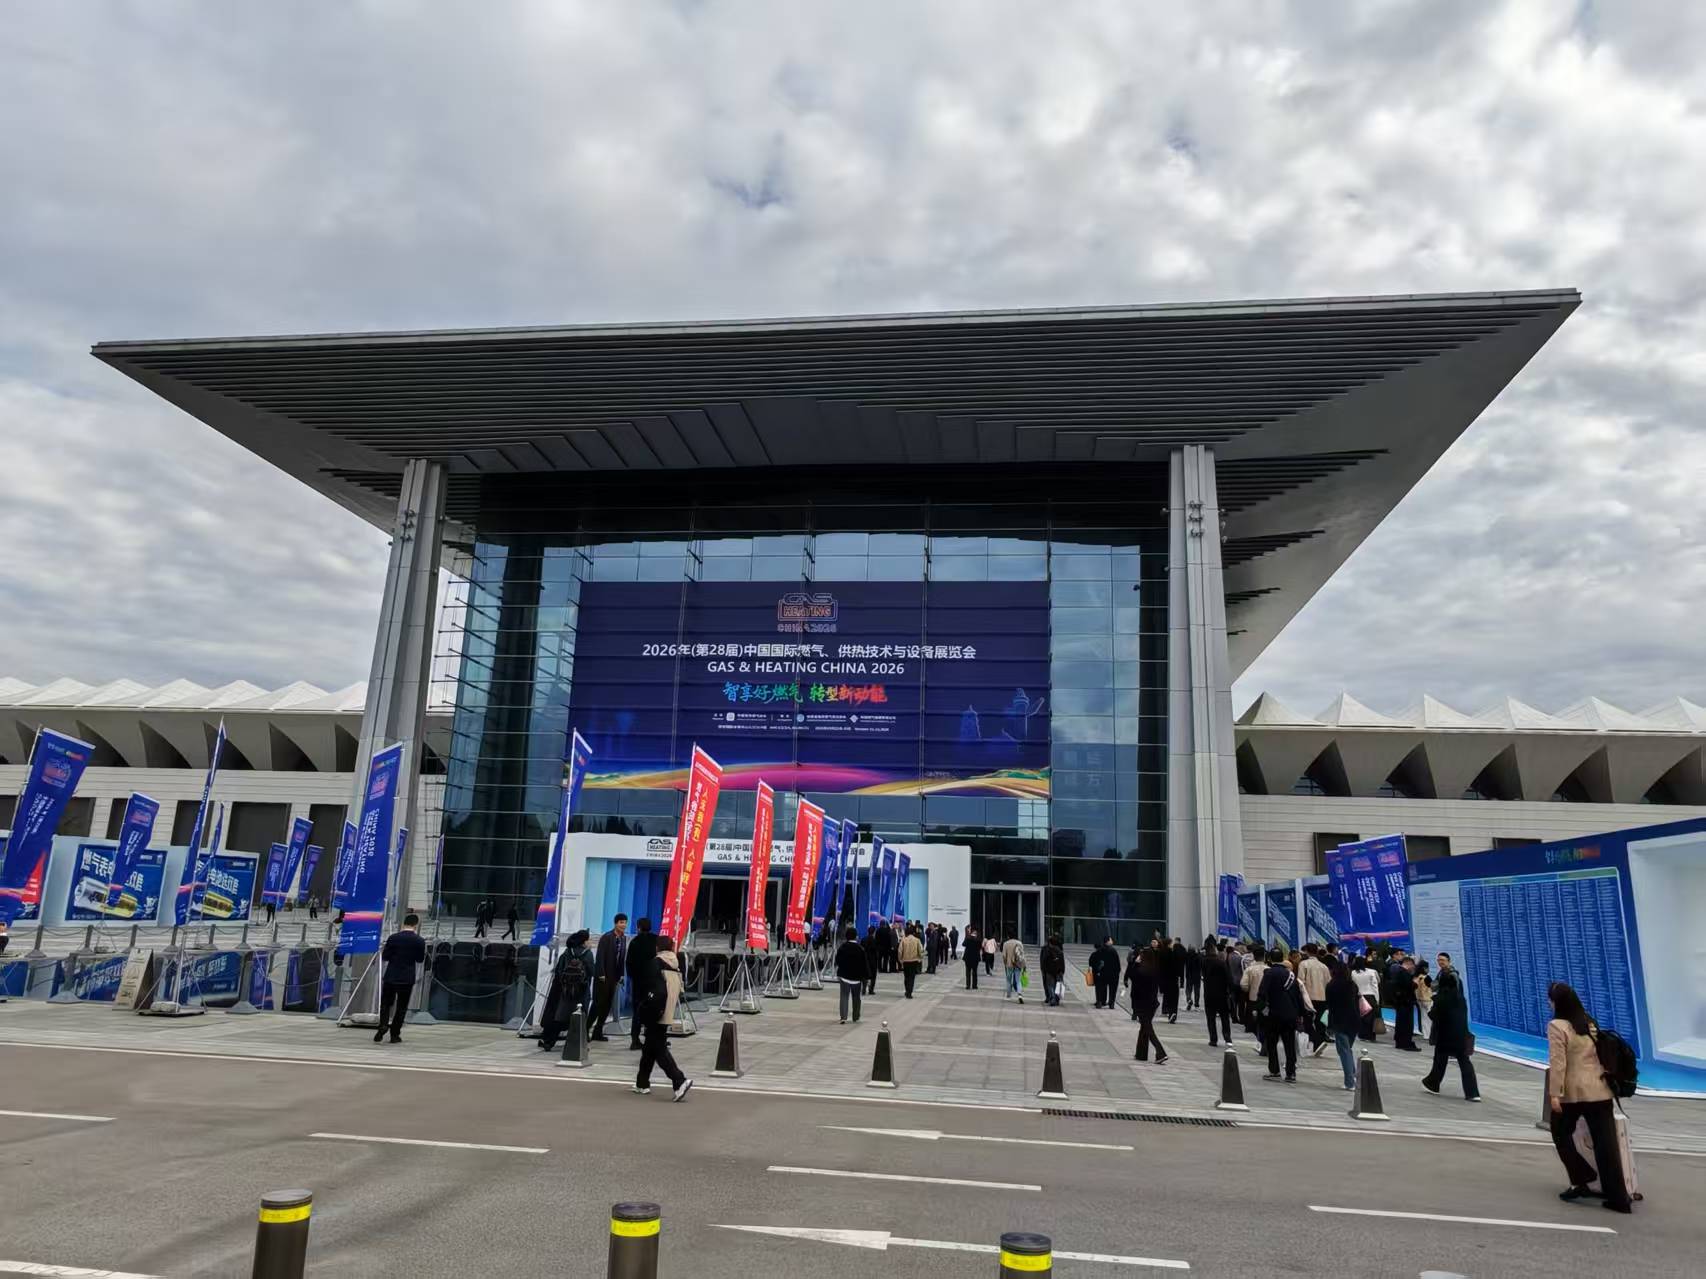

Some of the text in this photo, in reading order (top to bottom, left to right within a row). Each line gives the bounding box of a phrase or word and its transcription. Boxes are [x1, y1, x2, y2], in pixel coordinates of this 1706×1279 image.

[707, 661, 905, 675] GAS & HEATING CHINA 2026
[722, 681, 888, 706] 智享好燃气 转型新动能
[717, 853, 732, 861] GAS
